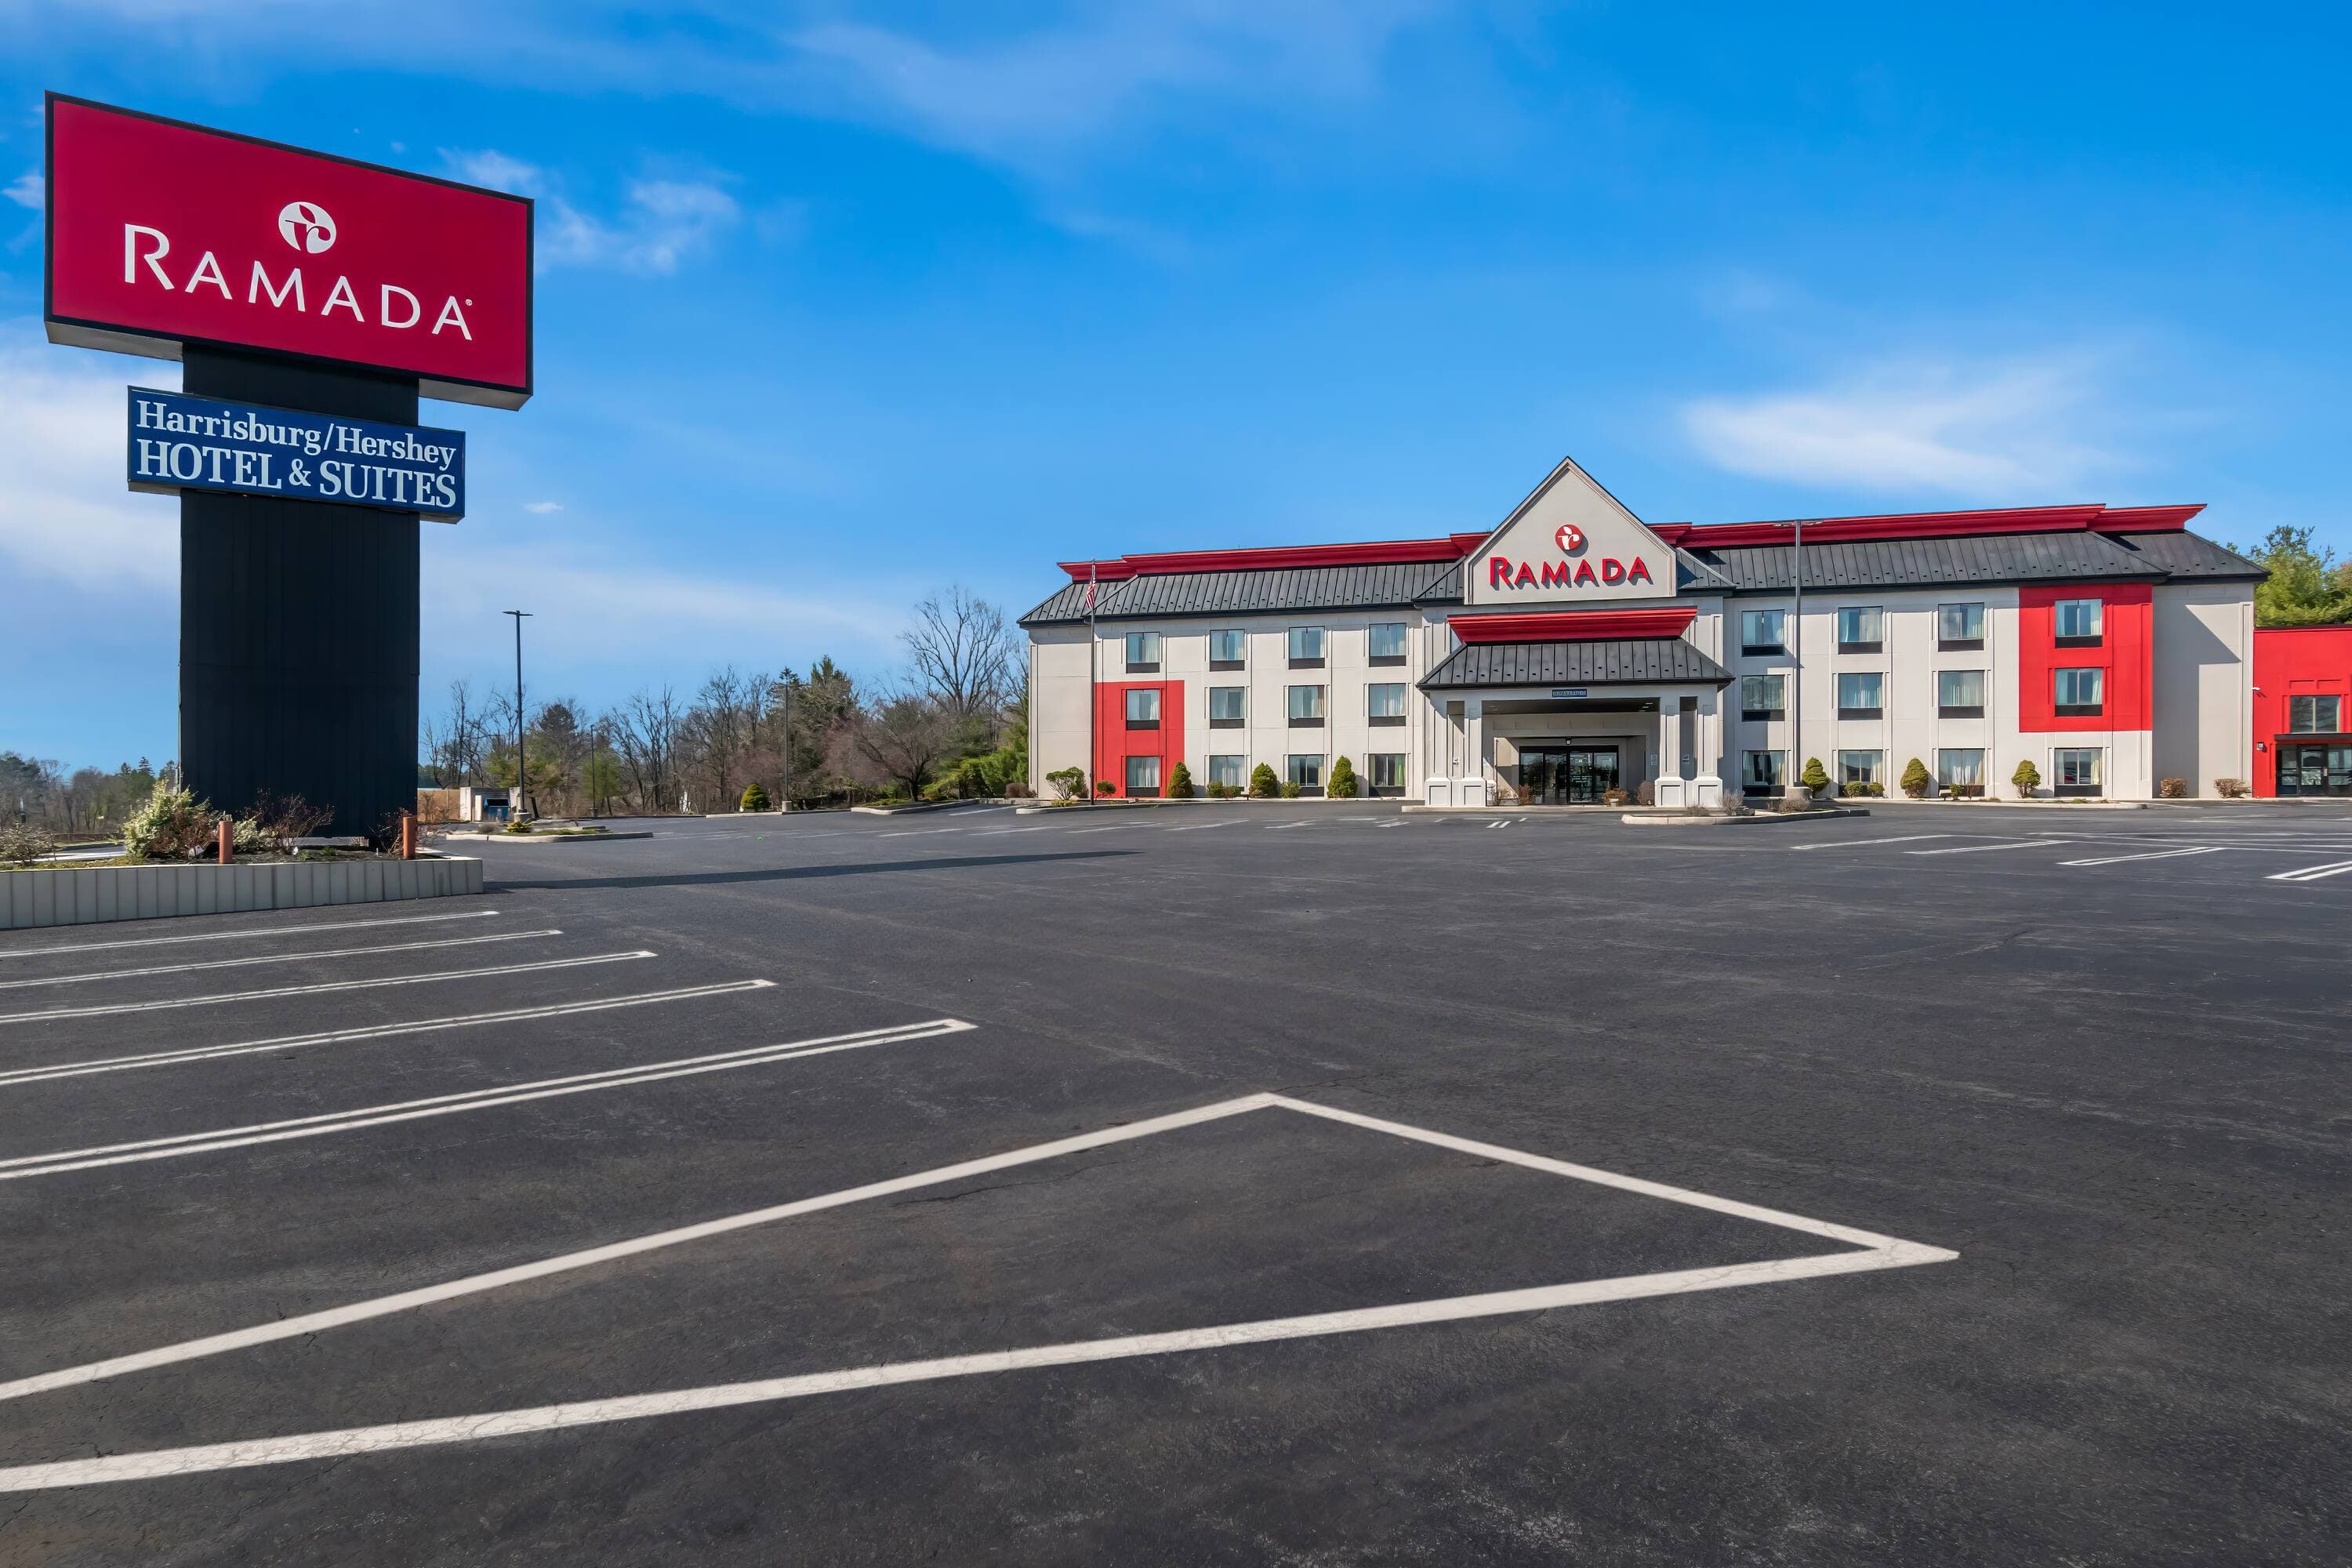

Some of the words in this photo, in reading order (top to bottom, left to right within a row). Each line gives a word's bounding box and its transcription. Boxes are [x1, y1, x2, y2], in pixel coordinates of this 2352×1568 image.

[125, 223, 473, 341] RAMADA
[136, 400, 457, 470] Harrisburg/Hershey
[136, 439, 281, 489] HOTEL
[289, 459, 311, 487] &
[320, 460, 457, 508] SUITES
[1490, 556, 1650, 586] RAMADA
